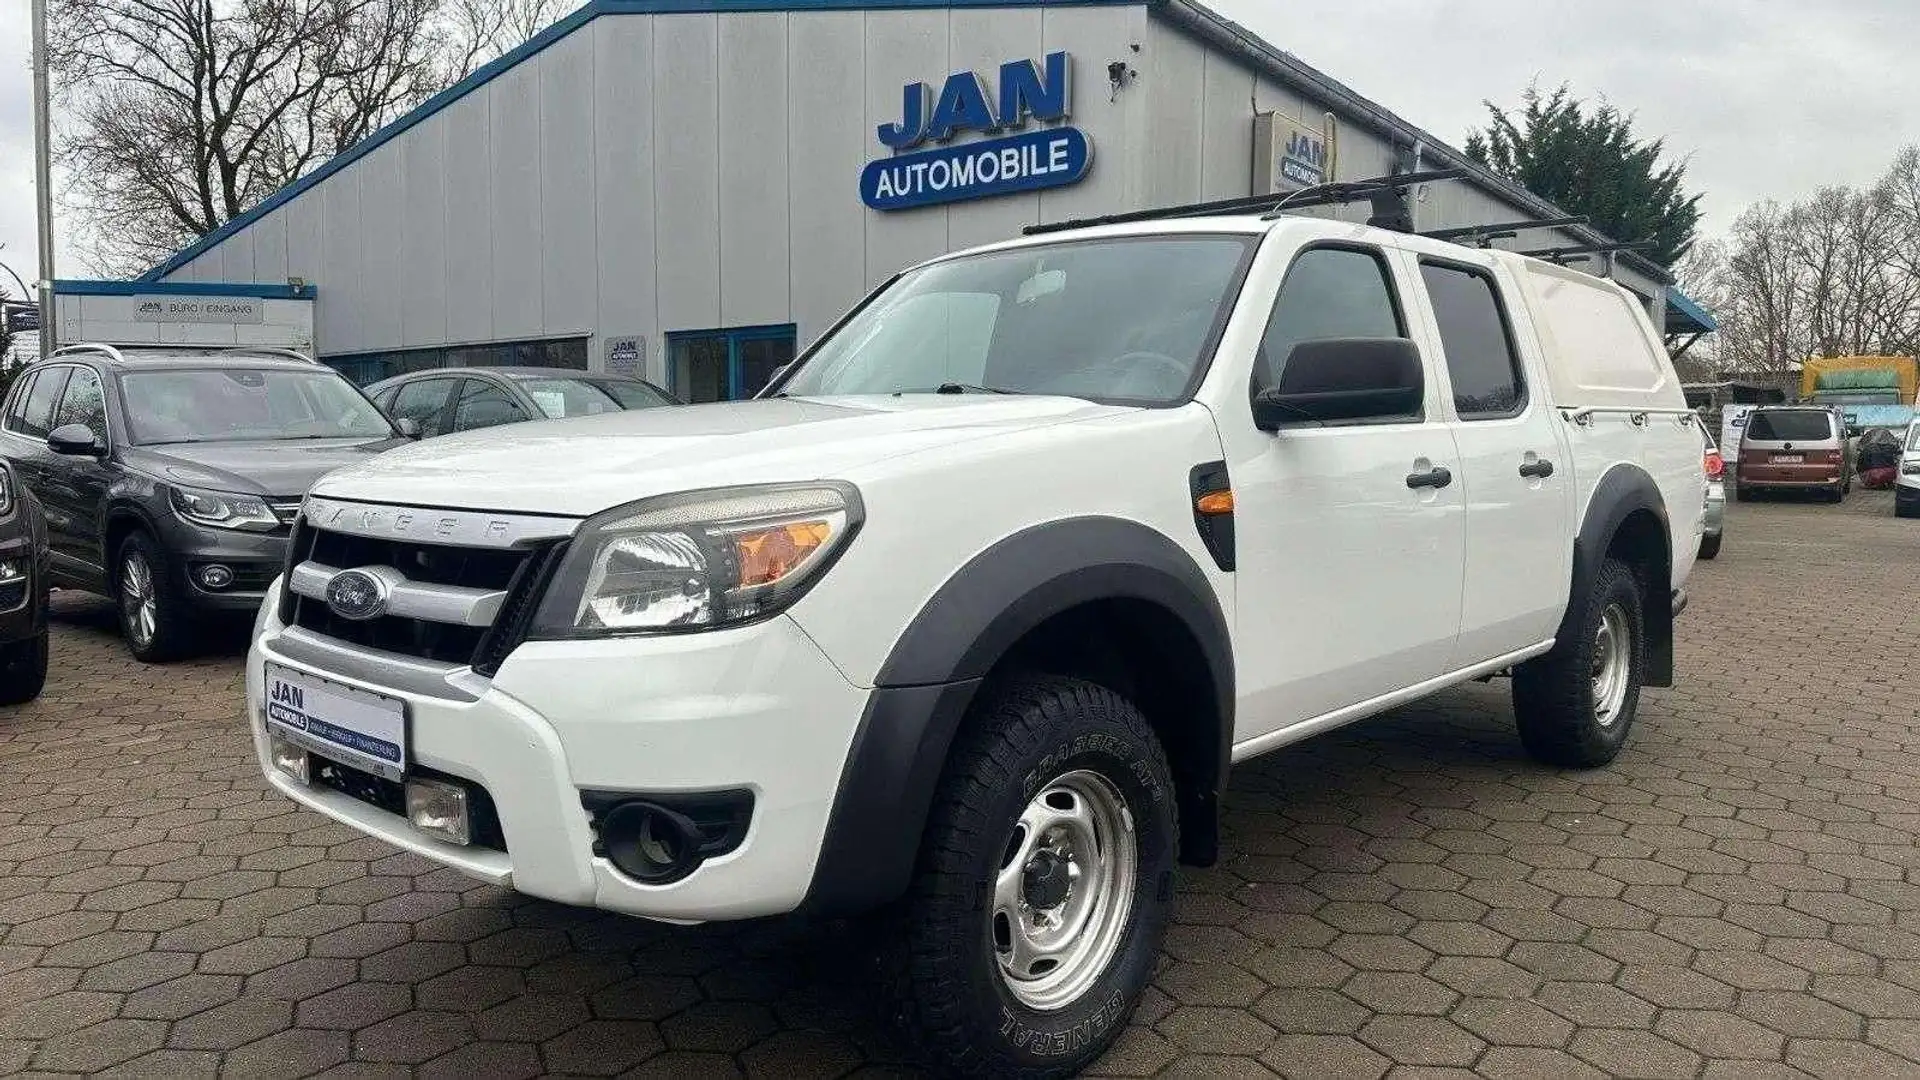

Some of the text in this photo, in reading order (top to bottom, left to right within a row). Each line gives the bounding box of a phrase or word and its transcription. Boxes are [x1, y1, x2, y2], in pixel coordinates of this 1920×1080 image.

[878, 51, 1070, 149] JAN
[875, 138, 1069, 200] AUTOMOBILE
[206, 304, 252, 313] EINGANG
[613, 341, 636, 351] JAN
[271, 681, 304, 708] JAN
[1000, 989, 1125, 1056] GENERAL
